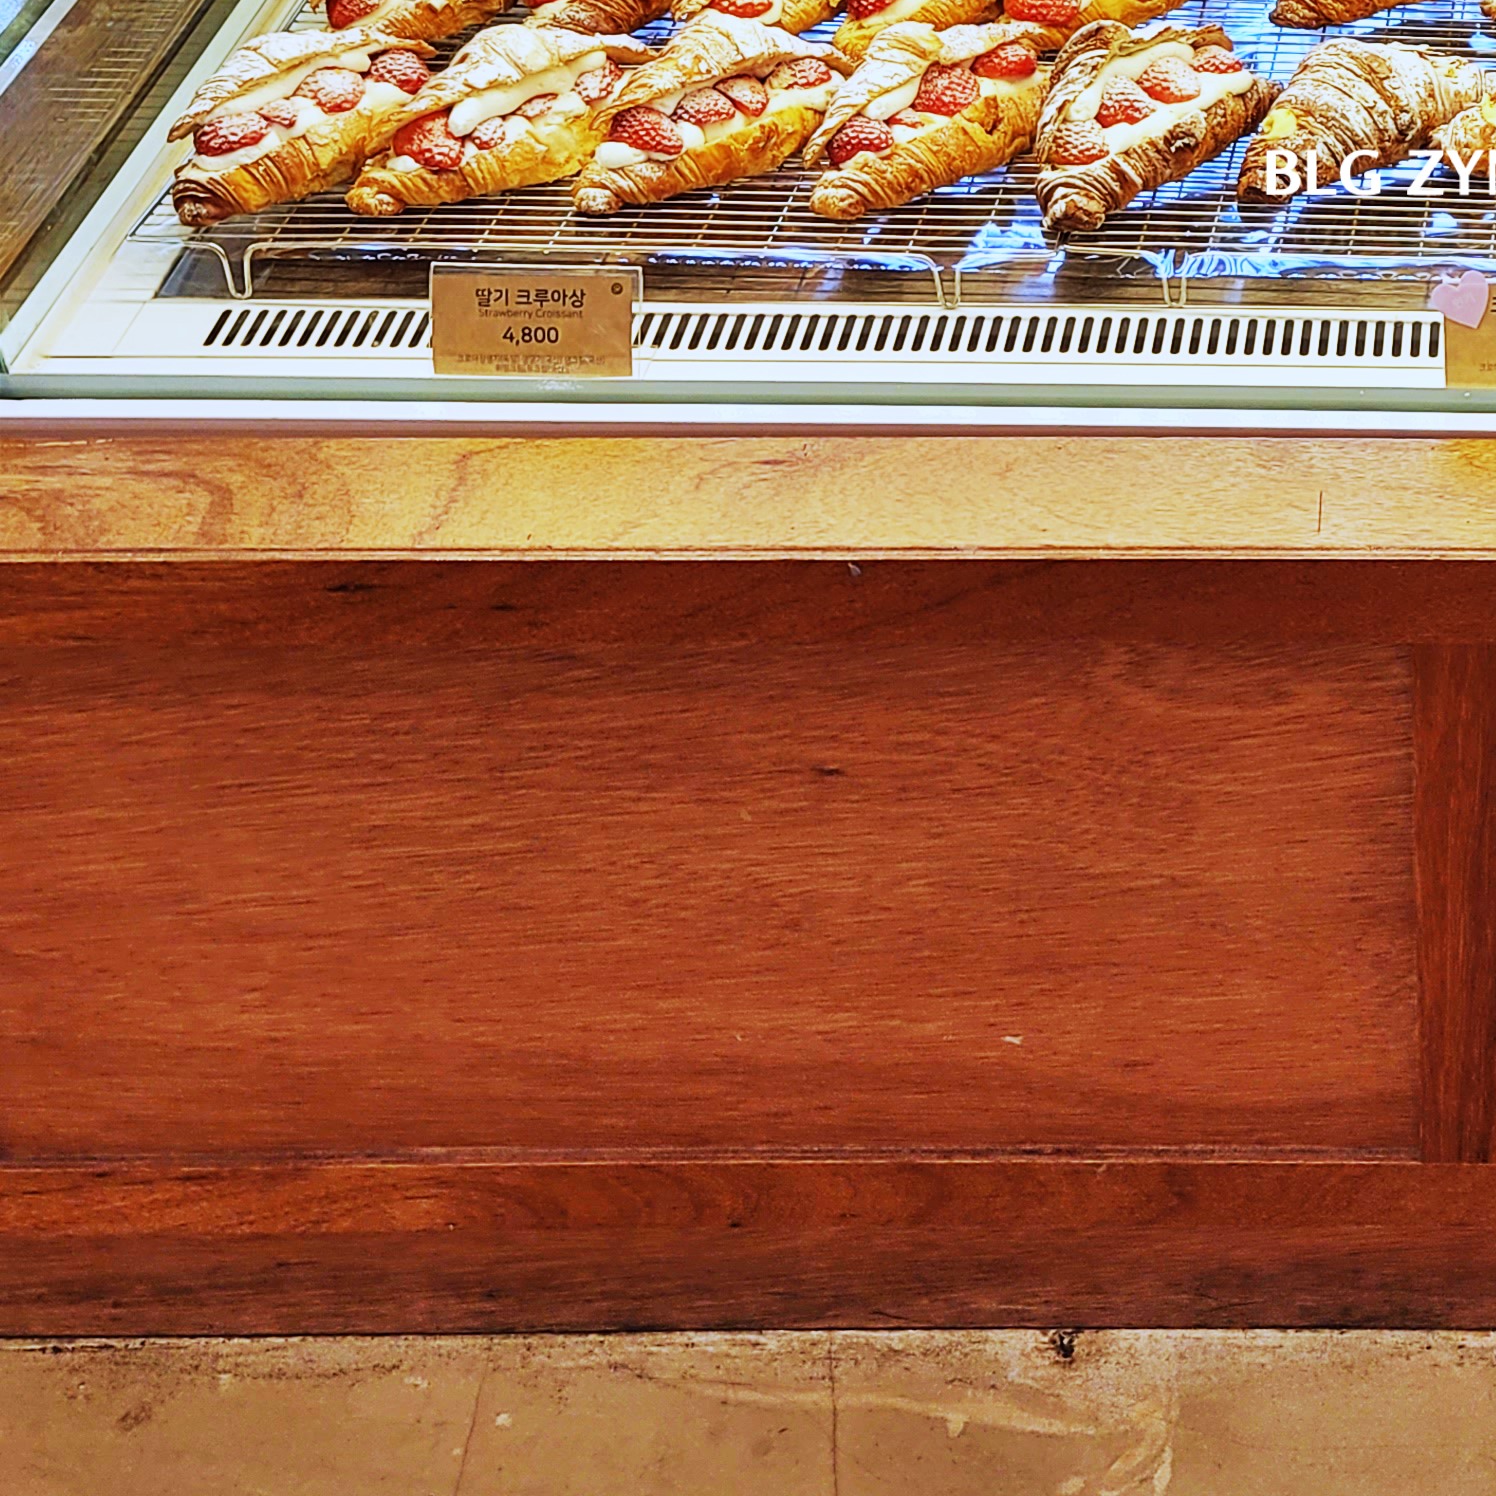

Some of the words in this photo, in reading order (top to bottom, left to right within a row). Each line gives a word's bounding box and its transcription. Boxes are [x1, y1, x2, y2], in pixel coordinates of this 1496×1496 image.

[475, 288, 509, 308] 딸기
[515, 288, 586, 308] 크루아상
[478, 308, 533, 319] Strawberry
[535, 308, 584, 319] Croissant
[502, 326, 559, 346] 4,800
